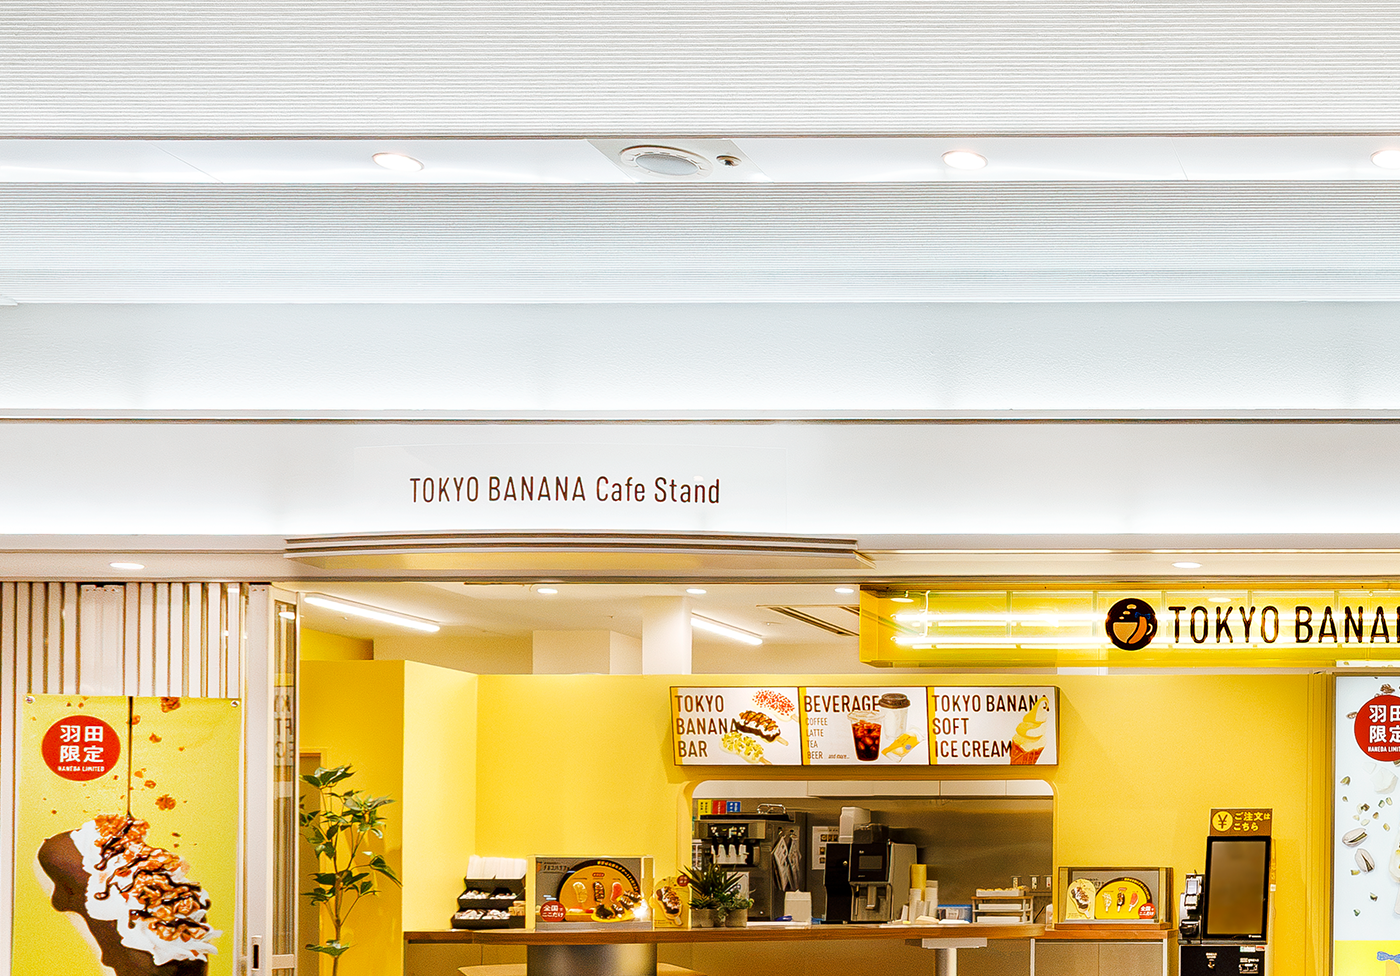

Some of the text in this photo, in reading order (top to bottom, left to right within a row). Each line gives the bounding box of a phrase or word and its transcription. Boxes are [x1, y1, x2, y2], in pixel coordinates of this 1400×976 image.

[409, 476, 720, 504] TOKYO BANANA Cafe Stand
[1168, 605, 1280, 644] TOKYO
[674, 695, 724, 713] TOKYO
[803, 695, 881, 713] BEVERAGE
[931, 694, 981, 712] TOKYO
[676, 718, 739, 735] BANANA
[805, 717, 828, 726] COFFEE
[932, 717, 969, 735] SOFT
[60, 725, 104, 743] 羽田
[806, 728, 824, 737] LATTE
[677, 740, 708, 758] BAR
[806, 740, 818, 748] TEA
[935, 740, 1012, 758] ICE CREAM
[60, 745, 104, 763] 限定
[806, 751, 824, 760] BEER
[1234, 811, 1271, 822] ご注文は
[1233, 821, 1259, 832] こちら
